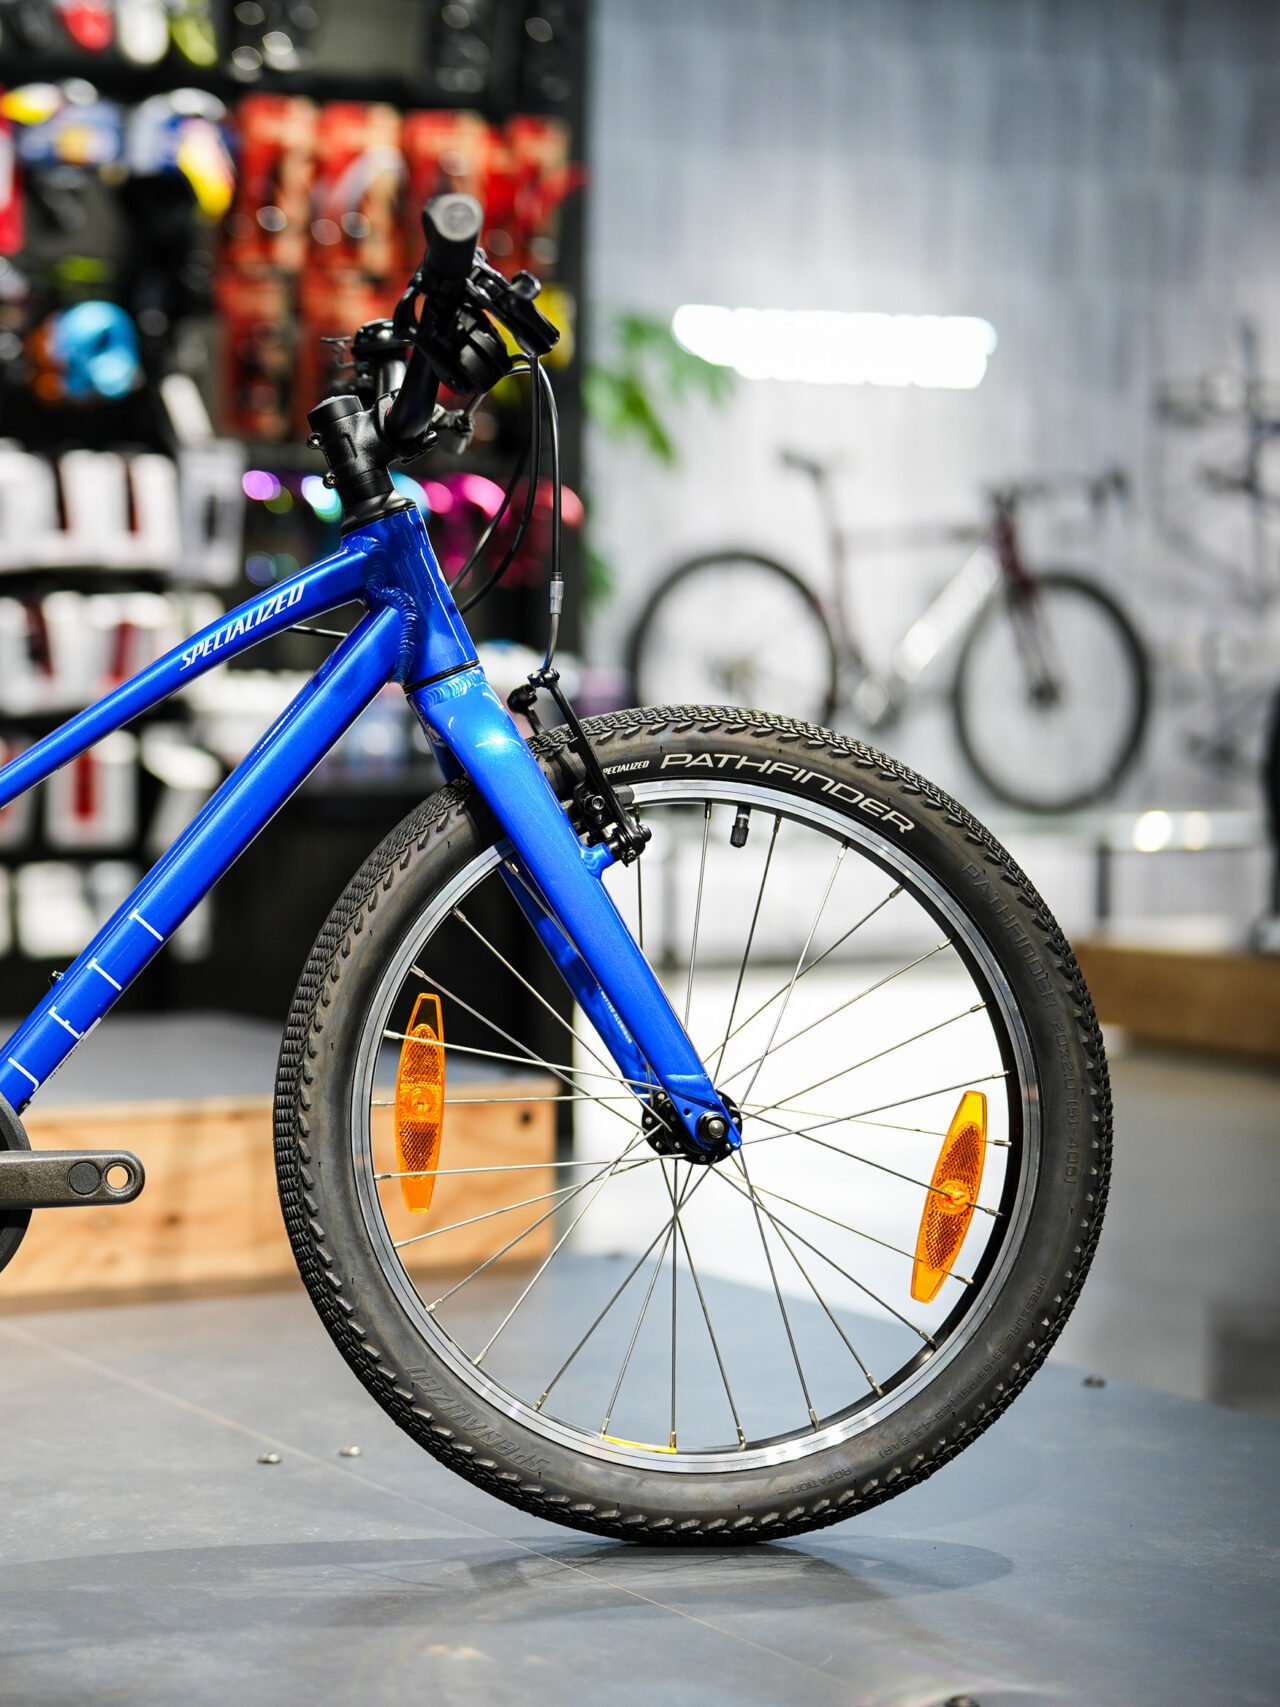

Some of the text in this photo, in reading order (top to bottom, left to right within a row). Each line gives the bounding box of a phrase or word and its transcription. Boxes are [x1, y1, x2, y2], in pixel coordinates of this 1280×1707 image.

[179, 580, 306, 672] SPECIALIZED
[602, 753, 916, 834] PECIALIZED PATHFINDER
[959, 858, 1059, 1010] PATHFINDER
[7, 907, 165, 1093] JETT
